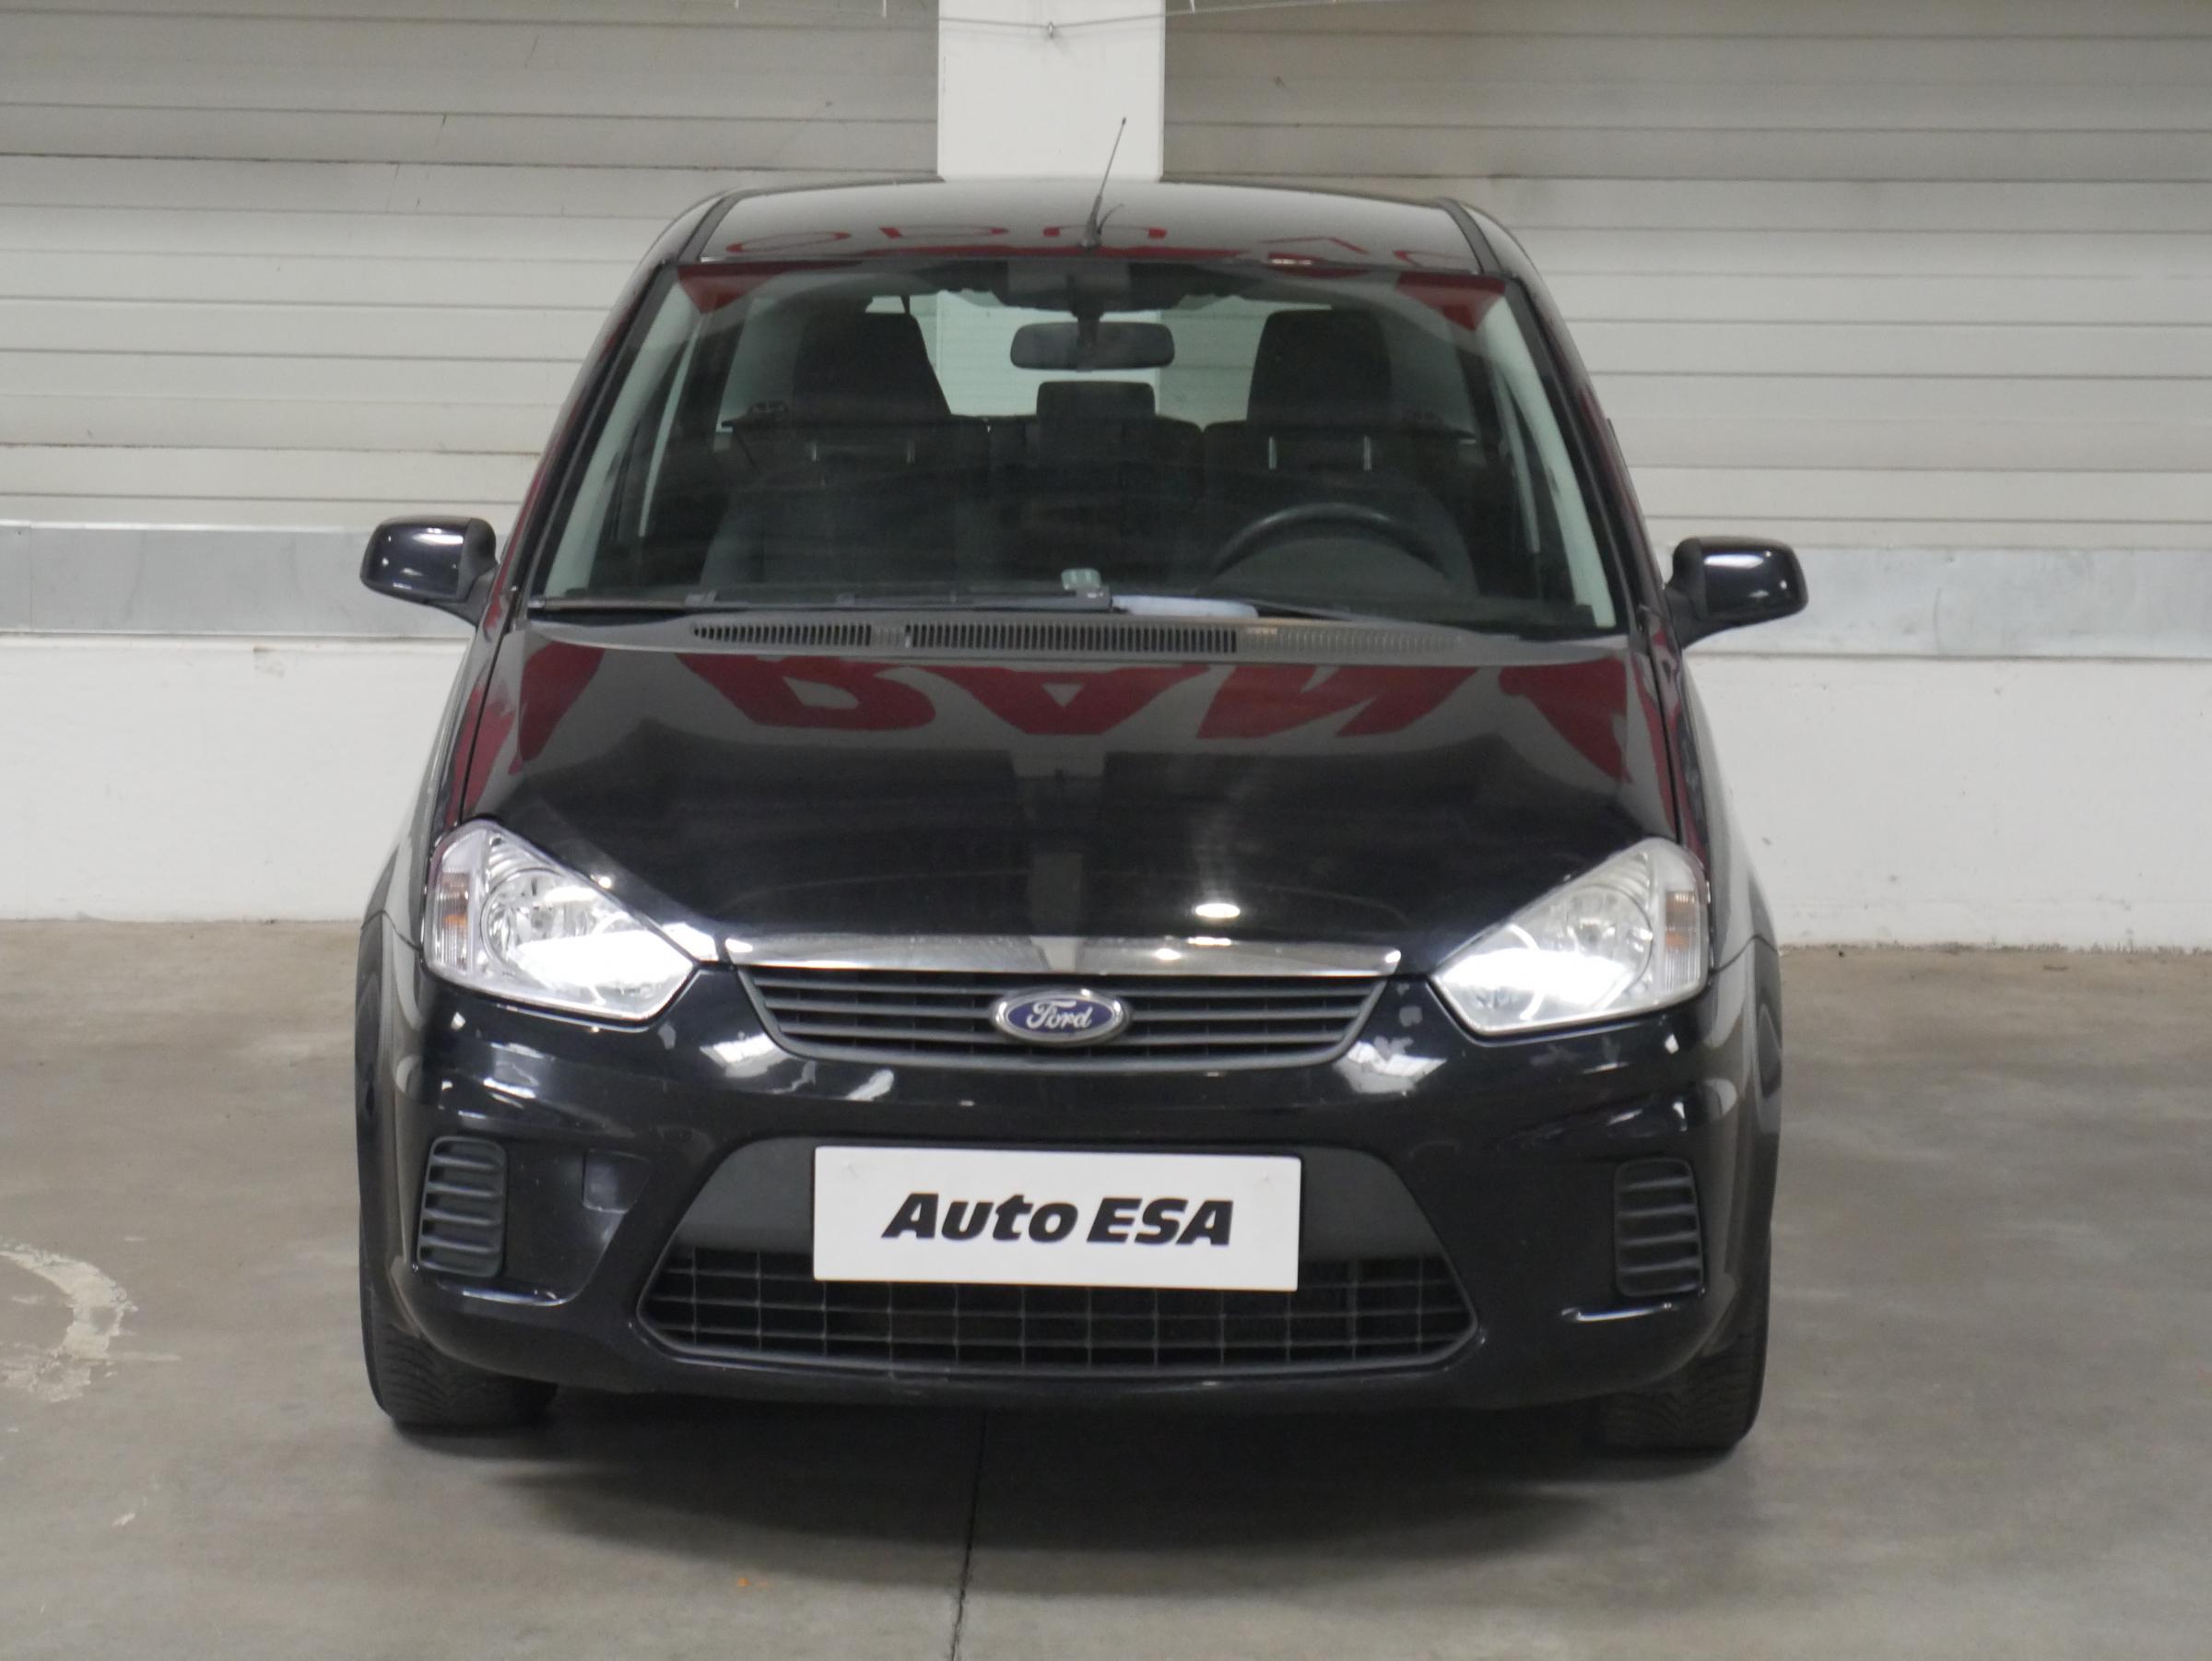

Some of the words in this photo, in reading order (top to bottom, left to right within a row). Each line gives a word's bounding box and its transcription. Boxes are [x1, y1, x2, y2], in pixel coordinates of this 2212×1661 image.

[1026, 1000, 1093, 1030] Ford
[881, 1192, 1078, 1243] Auto
[1086, 1196, 1234, 1246] ESA
